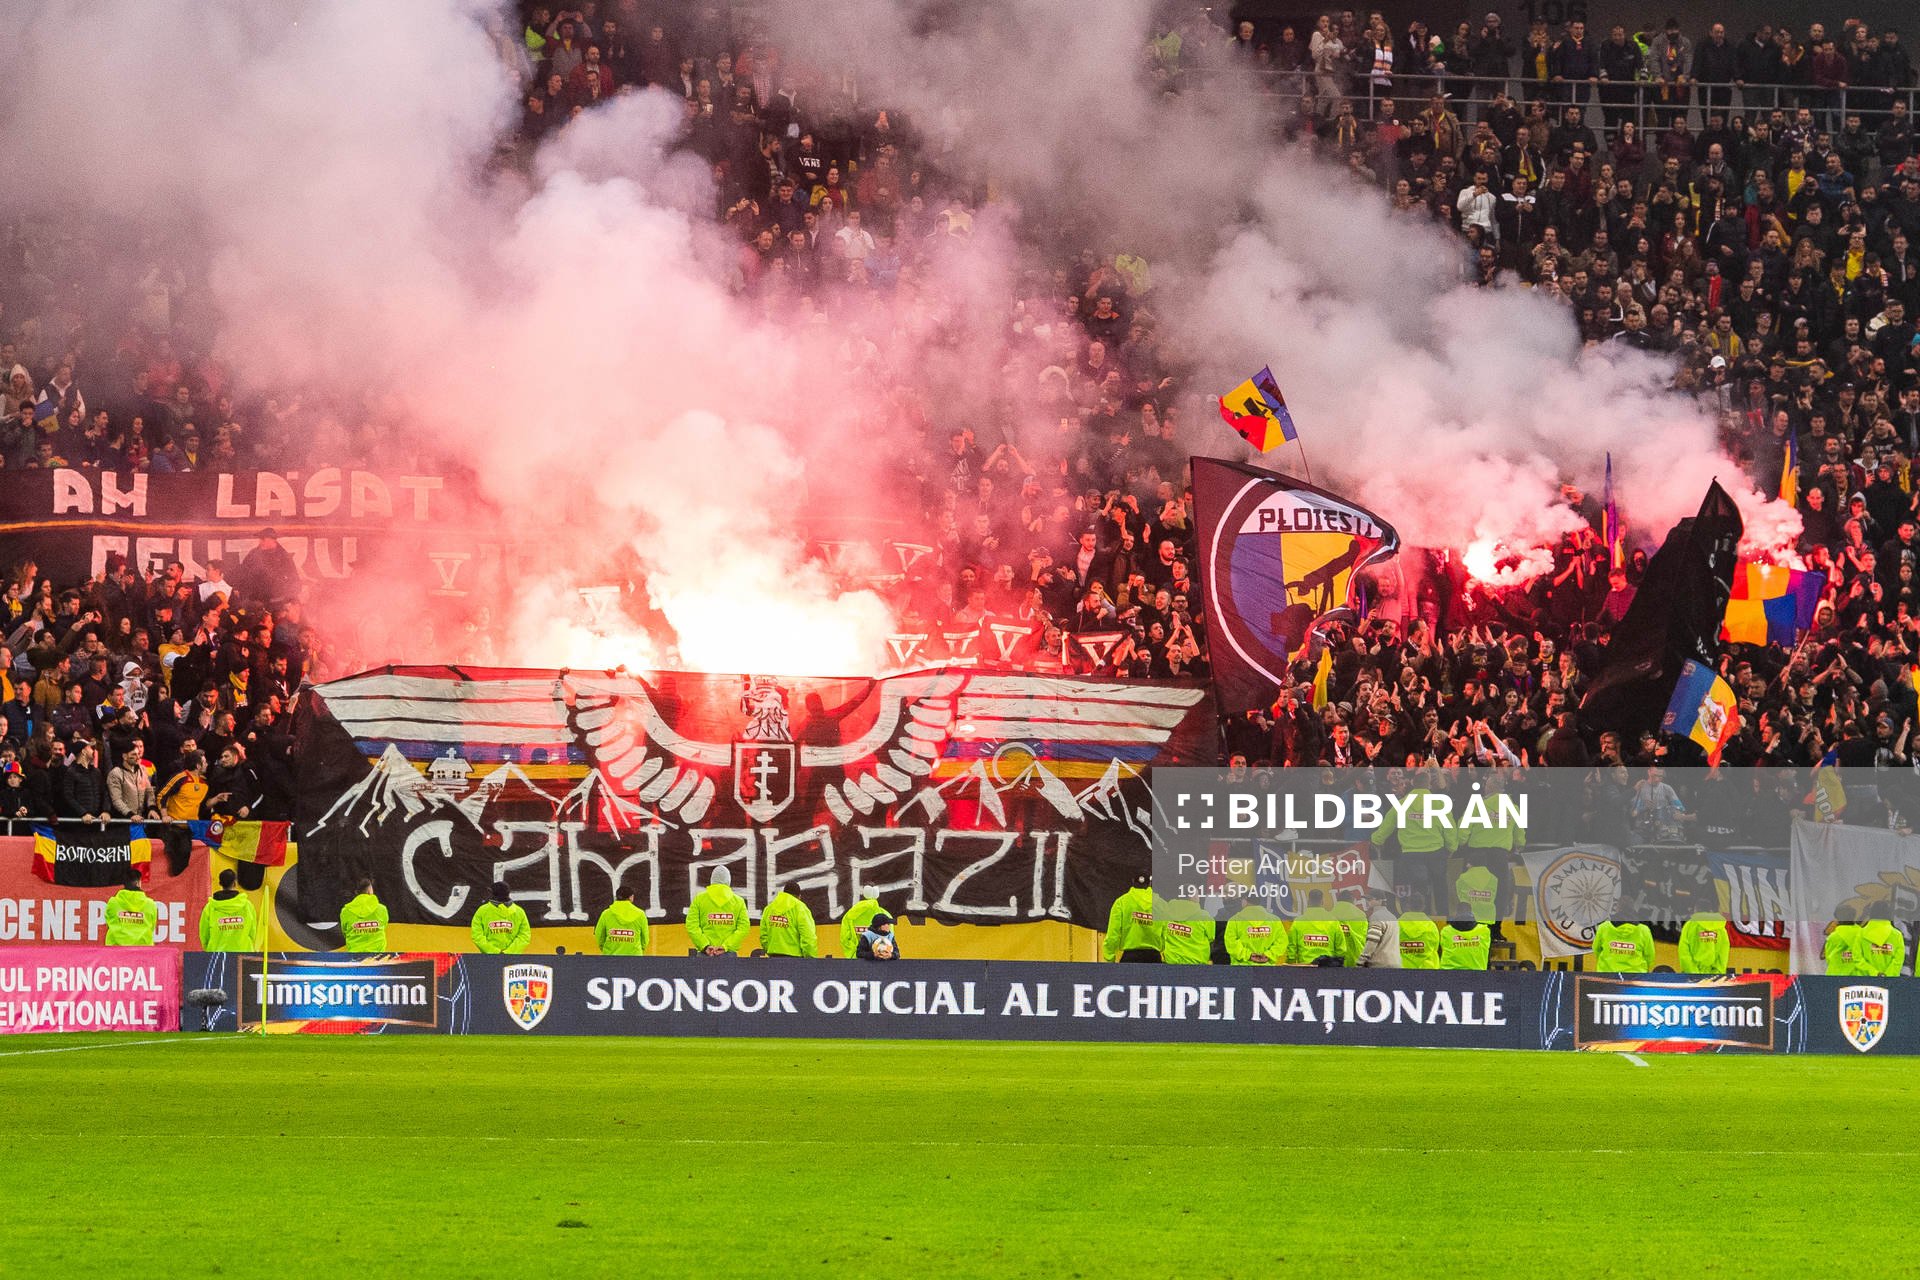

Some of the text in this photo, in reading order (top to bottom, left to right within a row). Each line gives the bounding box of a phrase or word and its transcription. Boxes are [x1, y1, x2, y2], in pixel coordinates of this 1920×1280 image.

[798, 156, 821, 168] VANS
[53, 469, 148, 517] AM
[42, 899, 81, 941] NE
[88, 900, 186, 943] PCE
[36, 967, 163, 992] PRINCIPAL
[508, 966, 548, 980] ROMÂNIA
[586, 977, 1507, 1033] SPONSOR OFICIAL AL ECHIPEI NAȚIONALE
[1844, 986, 1884, 1001] ROMÂNIA
[22, 1001, 158, 1033] NAȚIONALE
